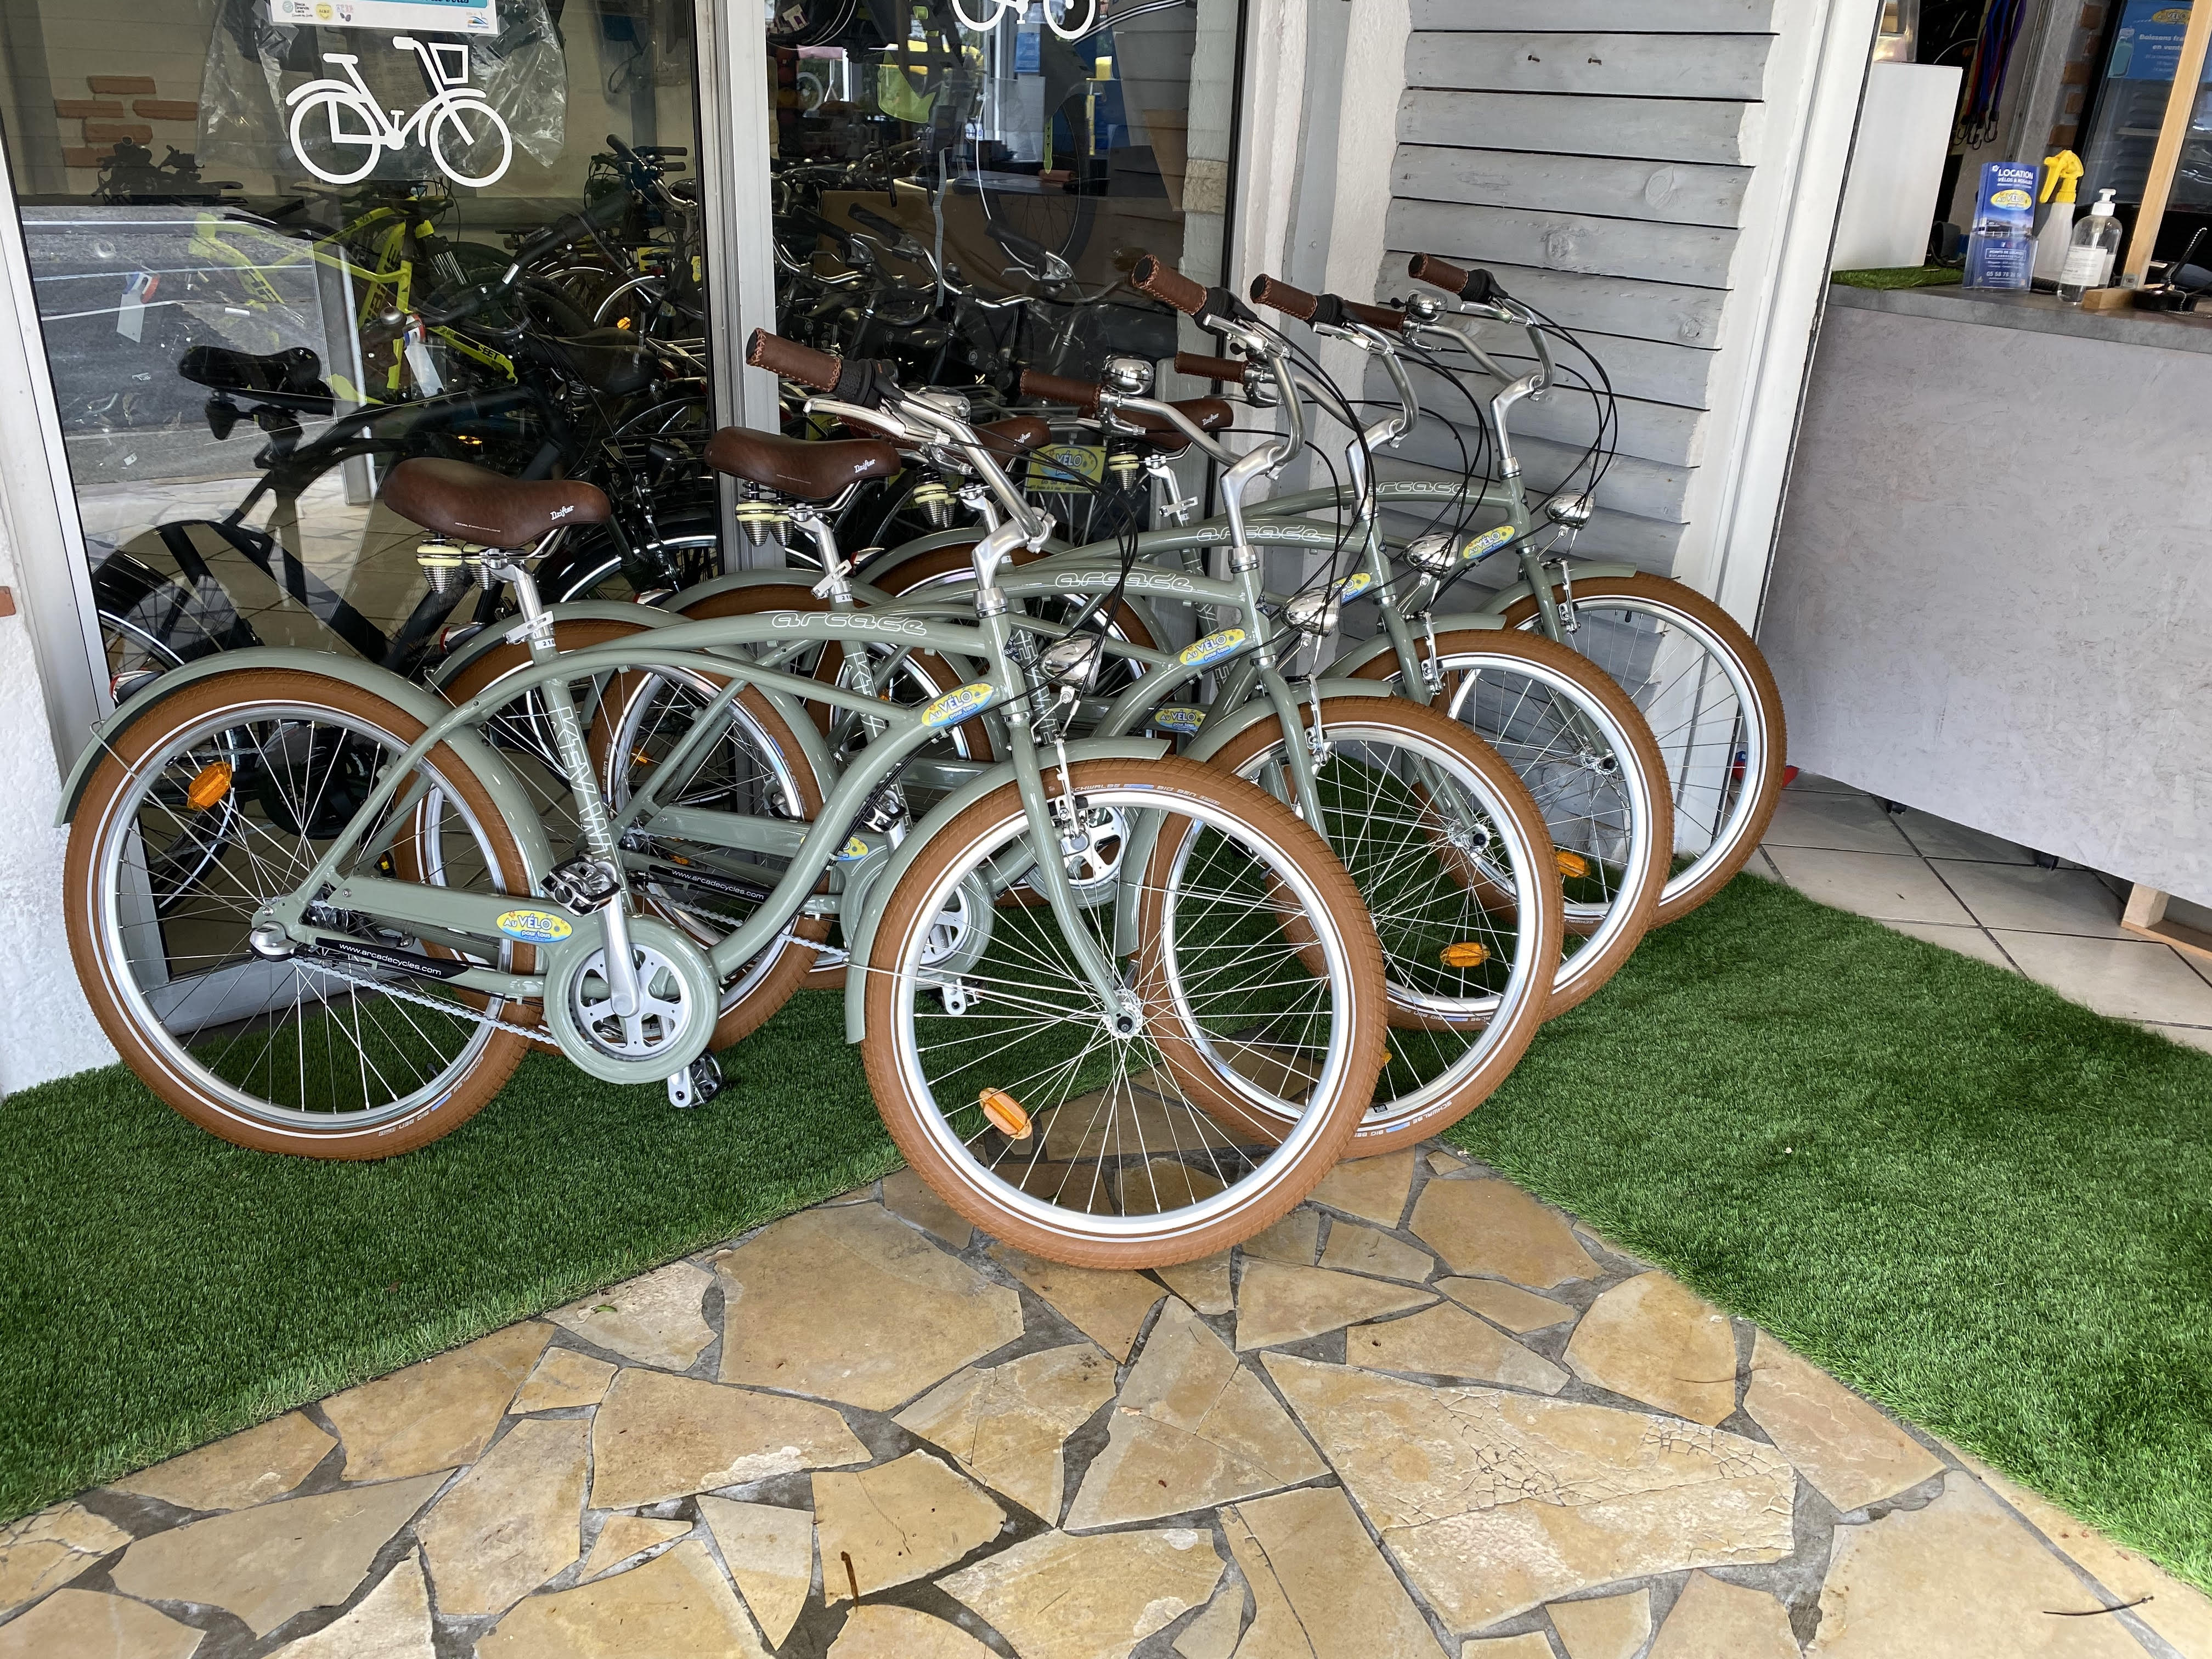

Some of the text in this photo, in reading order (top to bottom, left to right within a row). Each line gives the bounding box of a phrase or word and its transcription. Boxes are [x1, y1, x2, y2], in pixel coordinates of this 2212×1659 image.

[1998, 169, 2034, 179] LOCATION
[854, 459, 876, 473] Drifter
[1056, 450, 1082, 467] VÉLO
[550, 505, 575, 521] Drifter
[1476, 532, 1500, 549] VÉLO
[771, 612, 927, 636] arcade
[1186, 635, 1227, 661] Au VÉLO
[1204, 645, 1231, 661] pour tous
[929, 691, 973, 721] Au VÉLO
[949, 703, 978, 720] pour tous
[1171, 710, 1195, 721] VÉLO
[672, 870, 764, 900] www.arcadecycles.com
[504, 913, 552, 930] Au VÉLO
[537, 930, 551, 939] tous
[339, 944, 442, 975] www.arcadecycles.com
[398, 1054, 484, 1130] SCHWALBE BIG BEN
[1412, 1100, 1453, 1124] SCHWALBE
